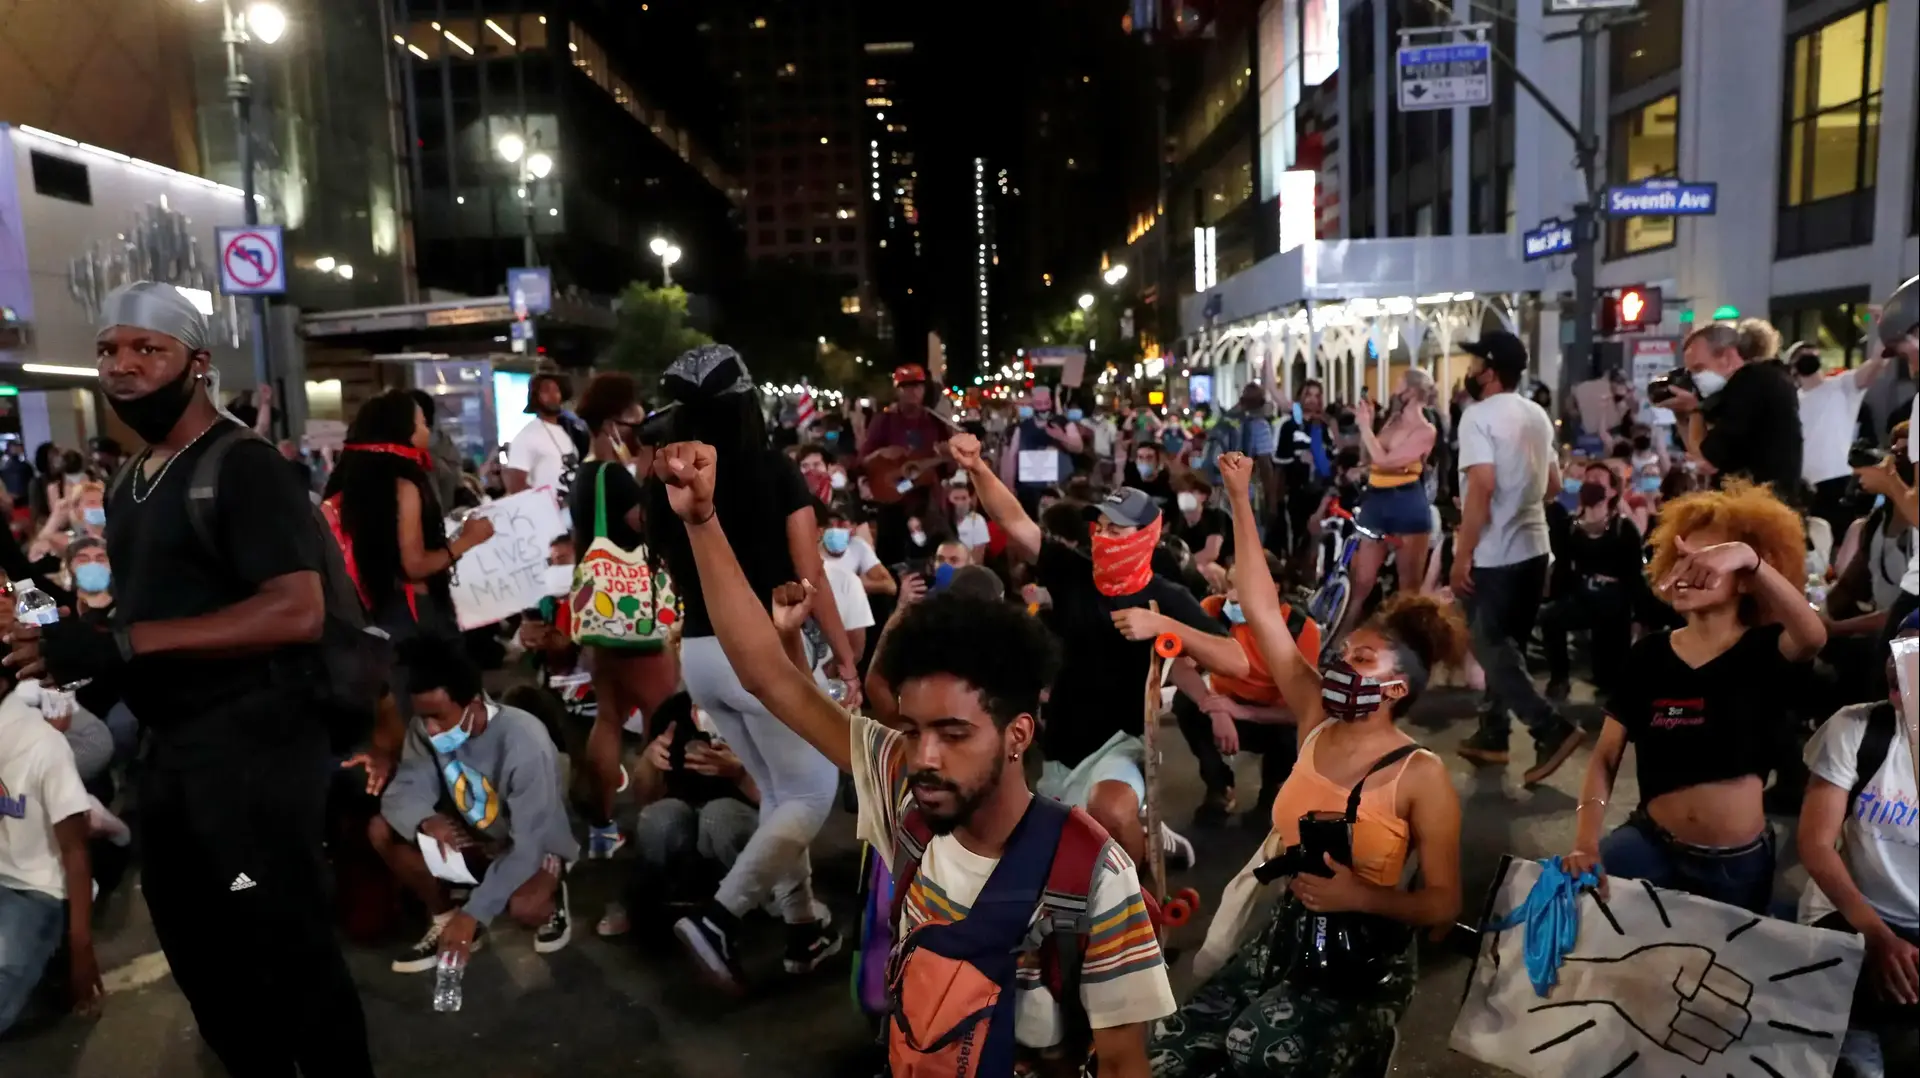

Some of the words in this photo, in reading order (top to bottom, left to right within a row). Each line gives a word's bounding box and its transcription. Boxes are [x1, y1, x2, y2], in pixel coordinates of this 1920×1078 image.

[1613, 191, 1677, 210] Seventh
[1679, 191, 1711, 209] Ave
[475, 535, 543, 575] LIVES
[469, 561, 546, 606] MATTE
[592, 562, 650, 579] TRADE
[605, 579, 649, 594] JOE'S
[230, 880, 257, 891] adidas
[1315, 916, 1327, 951] PYLE
[955, 1026, 977, 1078] atago
